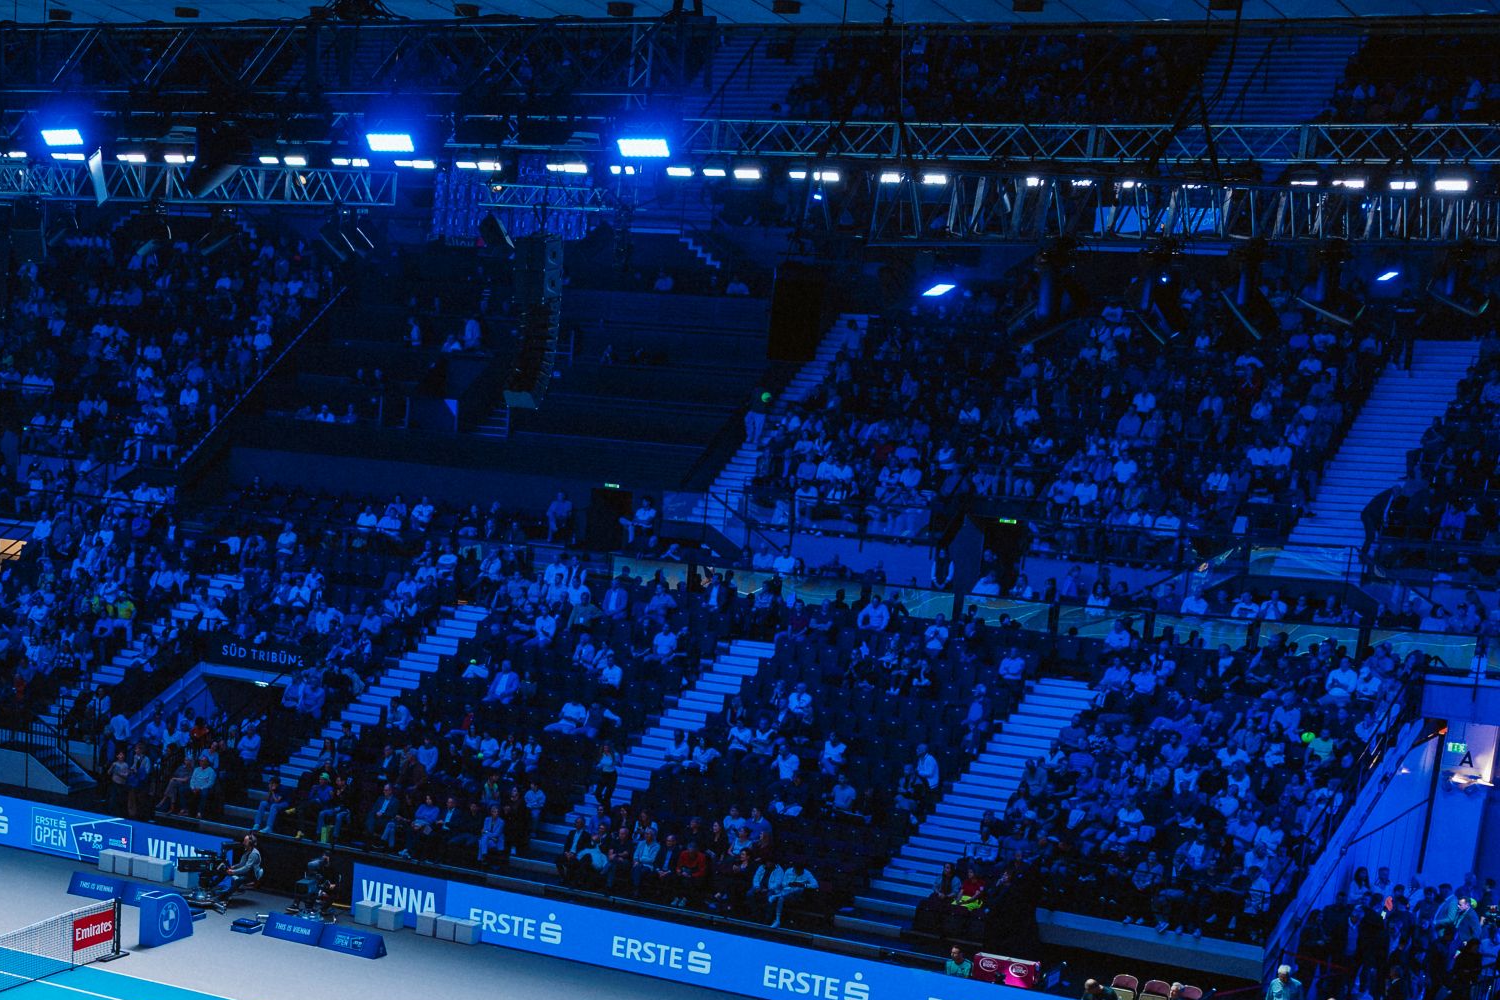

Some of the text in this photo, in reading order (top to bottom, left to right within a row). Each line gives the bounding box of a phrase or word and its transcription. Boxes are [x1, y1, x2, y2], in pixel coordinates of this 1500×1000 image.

[222, 643, 247, 658] SÜD
[1459, 751, 1473, 767] A
[36, 816, 58, 827] ERSTE
[35, 826, 67, 847] OPEN
[79, 880, 90, 889] THIS
[96, 884, 114, 893] VIENNA
[361, 879, 436, 914] VIENNA
[75, 920, 113, 941] Emirates
[275, 922, 286, 931] THIS
[292, 926, 311, 936] VIENNA
[469, 908, 536, 940] ERSTE
[612, 935, 684, 970] ERSTE
[763, 965, 840, 1000] ERSTE
